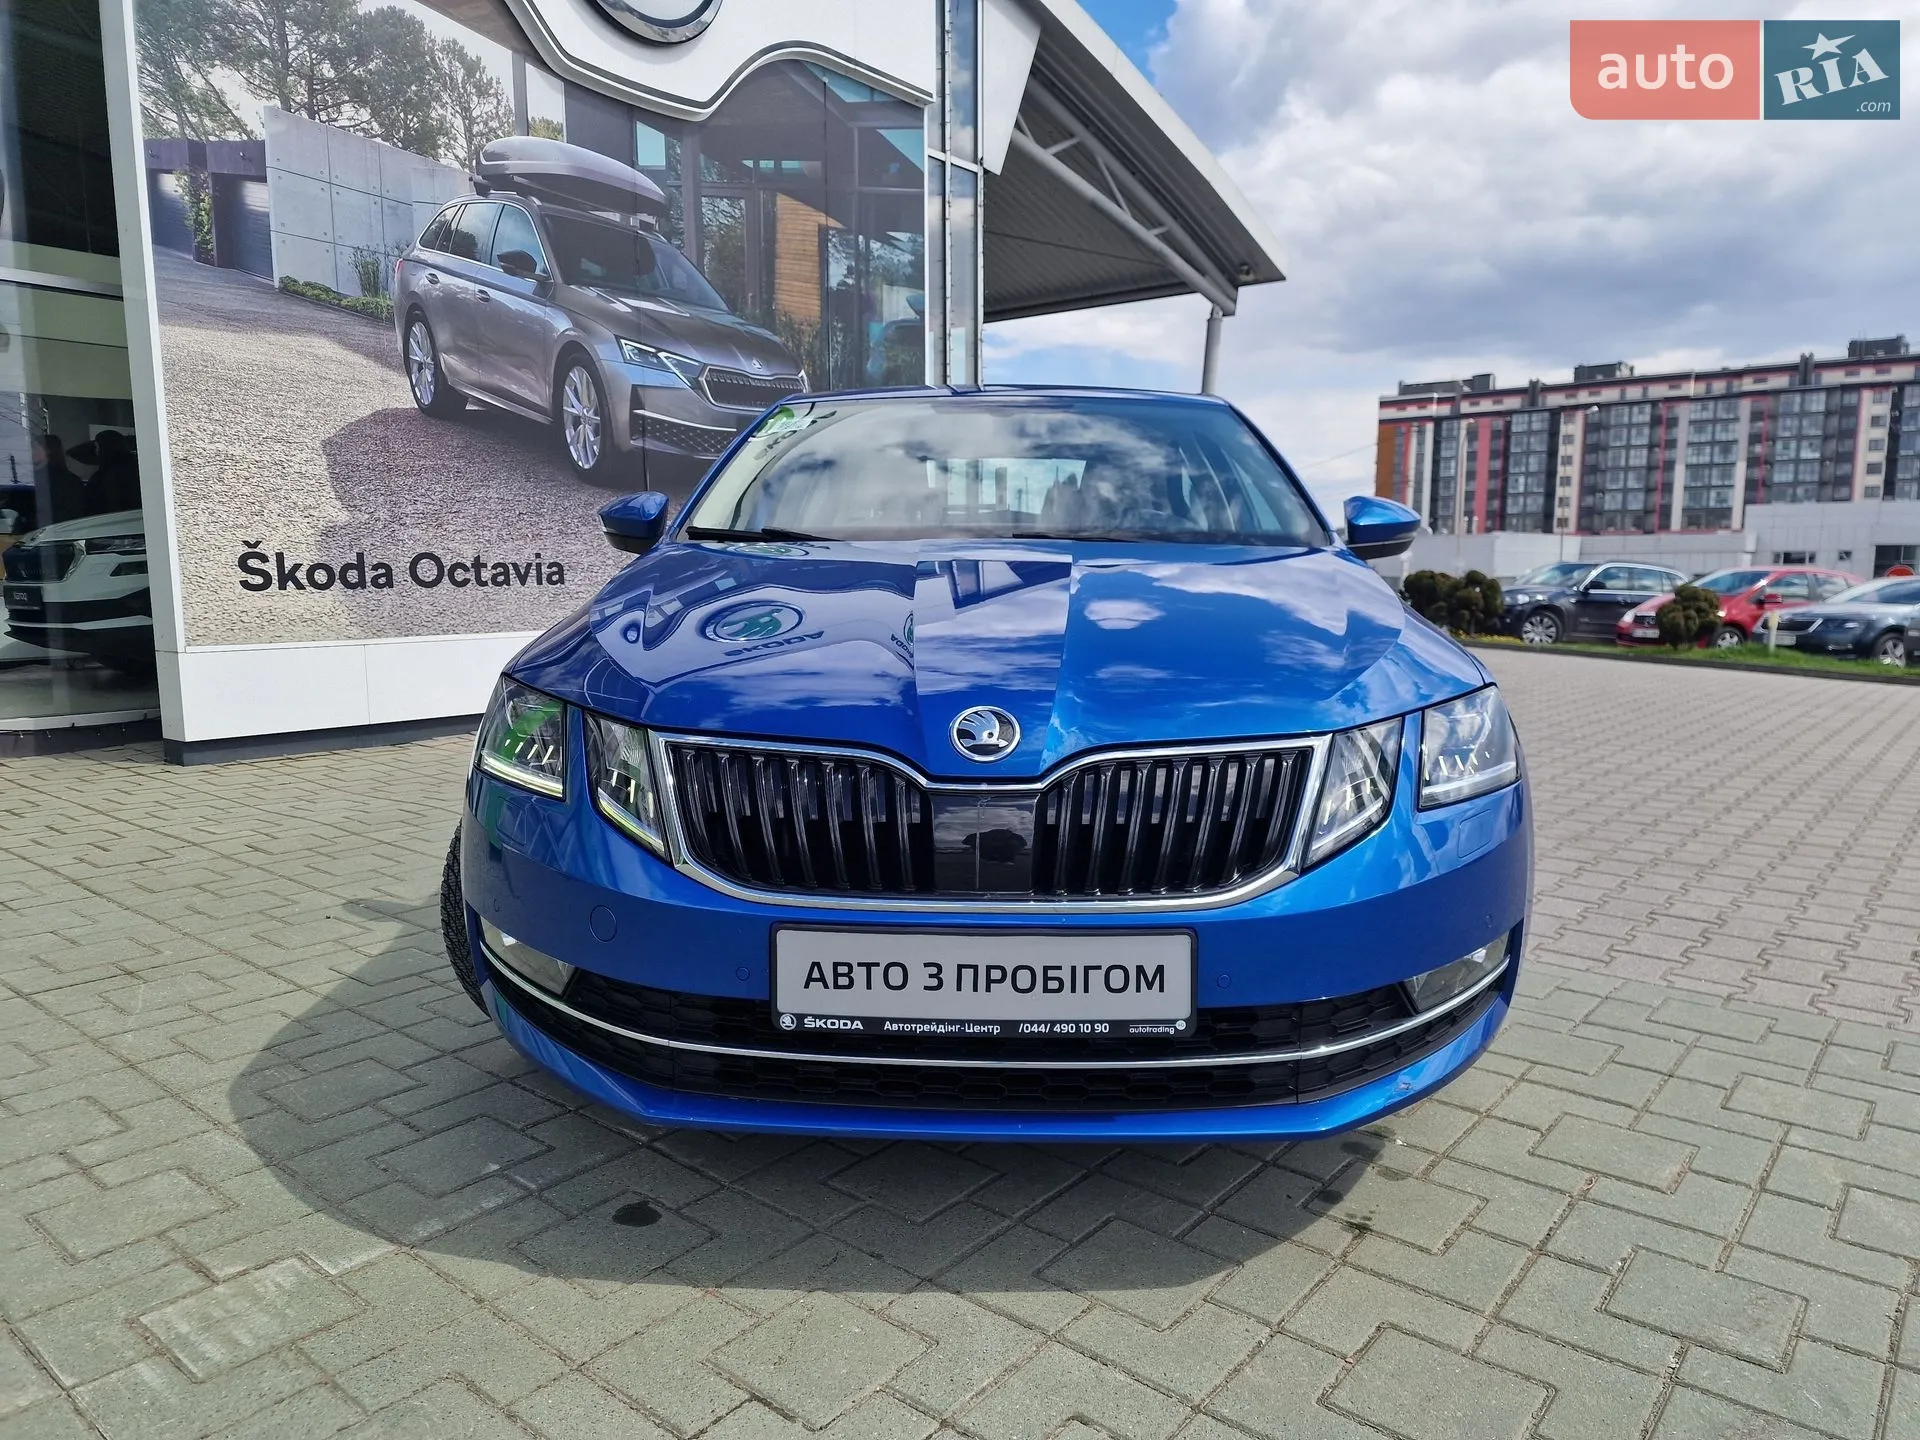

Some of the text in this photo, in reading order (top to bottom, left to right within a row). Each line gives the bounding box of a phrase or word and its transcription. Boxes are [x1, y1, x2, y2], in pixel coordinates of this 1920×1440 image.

[237, 540, 565, 592] Škoda Octavia
[803, 961, 1165, 994] АВТО З ПРОБІГОМ
[804, 1016, 864, 1030] ŠKODA
[883, 1021, 1001, 1035] Автотрейдінг-Центр
[1018, 1023, 1110, 1034] /044/ 490 10 90
[1129, 1026, 1175, 1035] autotrading
